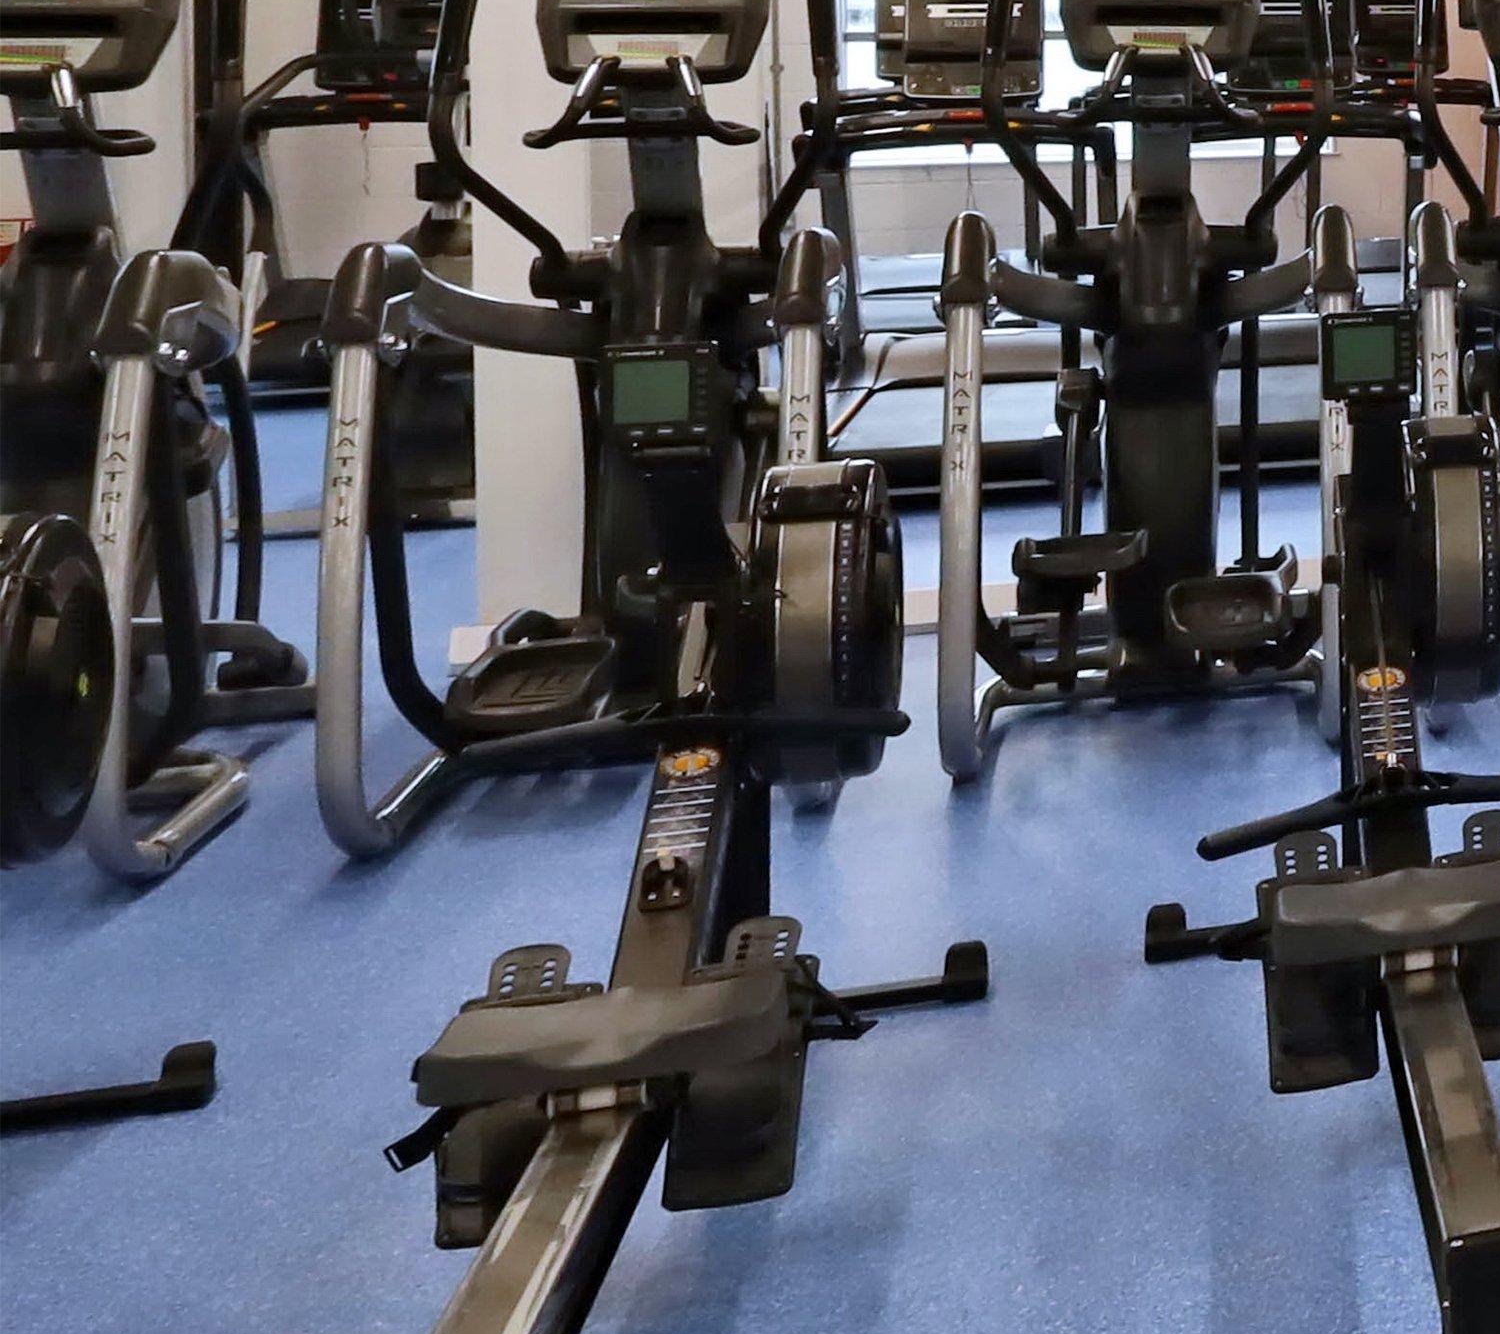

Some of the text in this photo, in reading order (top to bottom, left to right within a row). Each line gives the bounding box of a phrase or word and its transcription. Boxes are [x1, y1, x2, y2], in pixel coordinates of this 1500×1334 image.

[788, 395, 811, 461] MATR
[948, 371, 974, 473] MATRIX
[1430, 351, 1449, 412] MATR
[99, 430, 131, 544] MATRIX
[331, 418, 359, 528] MATRIX
